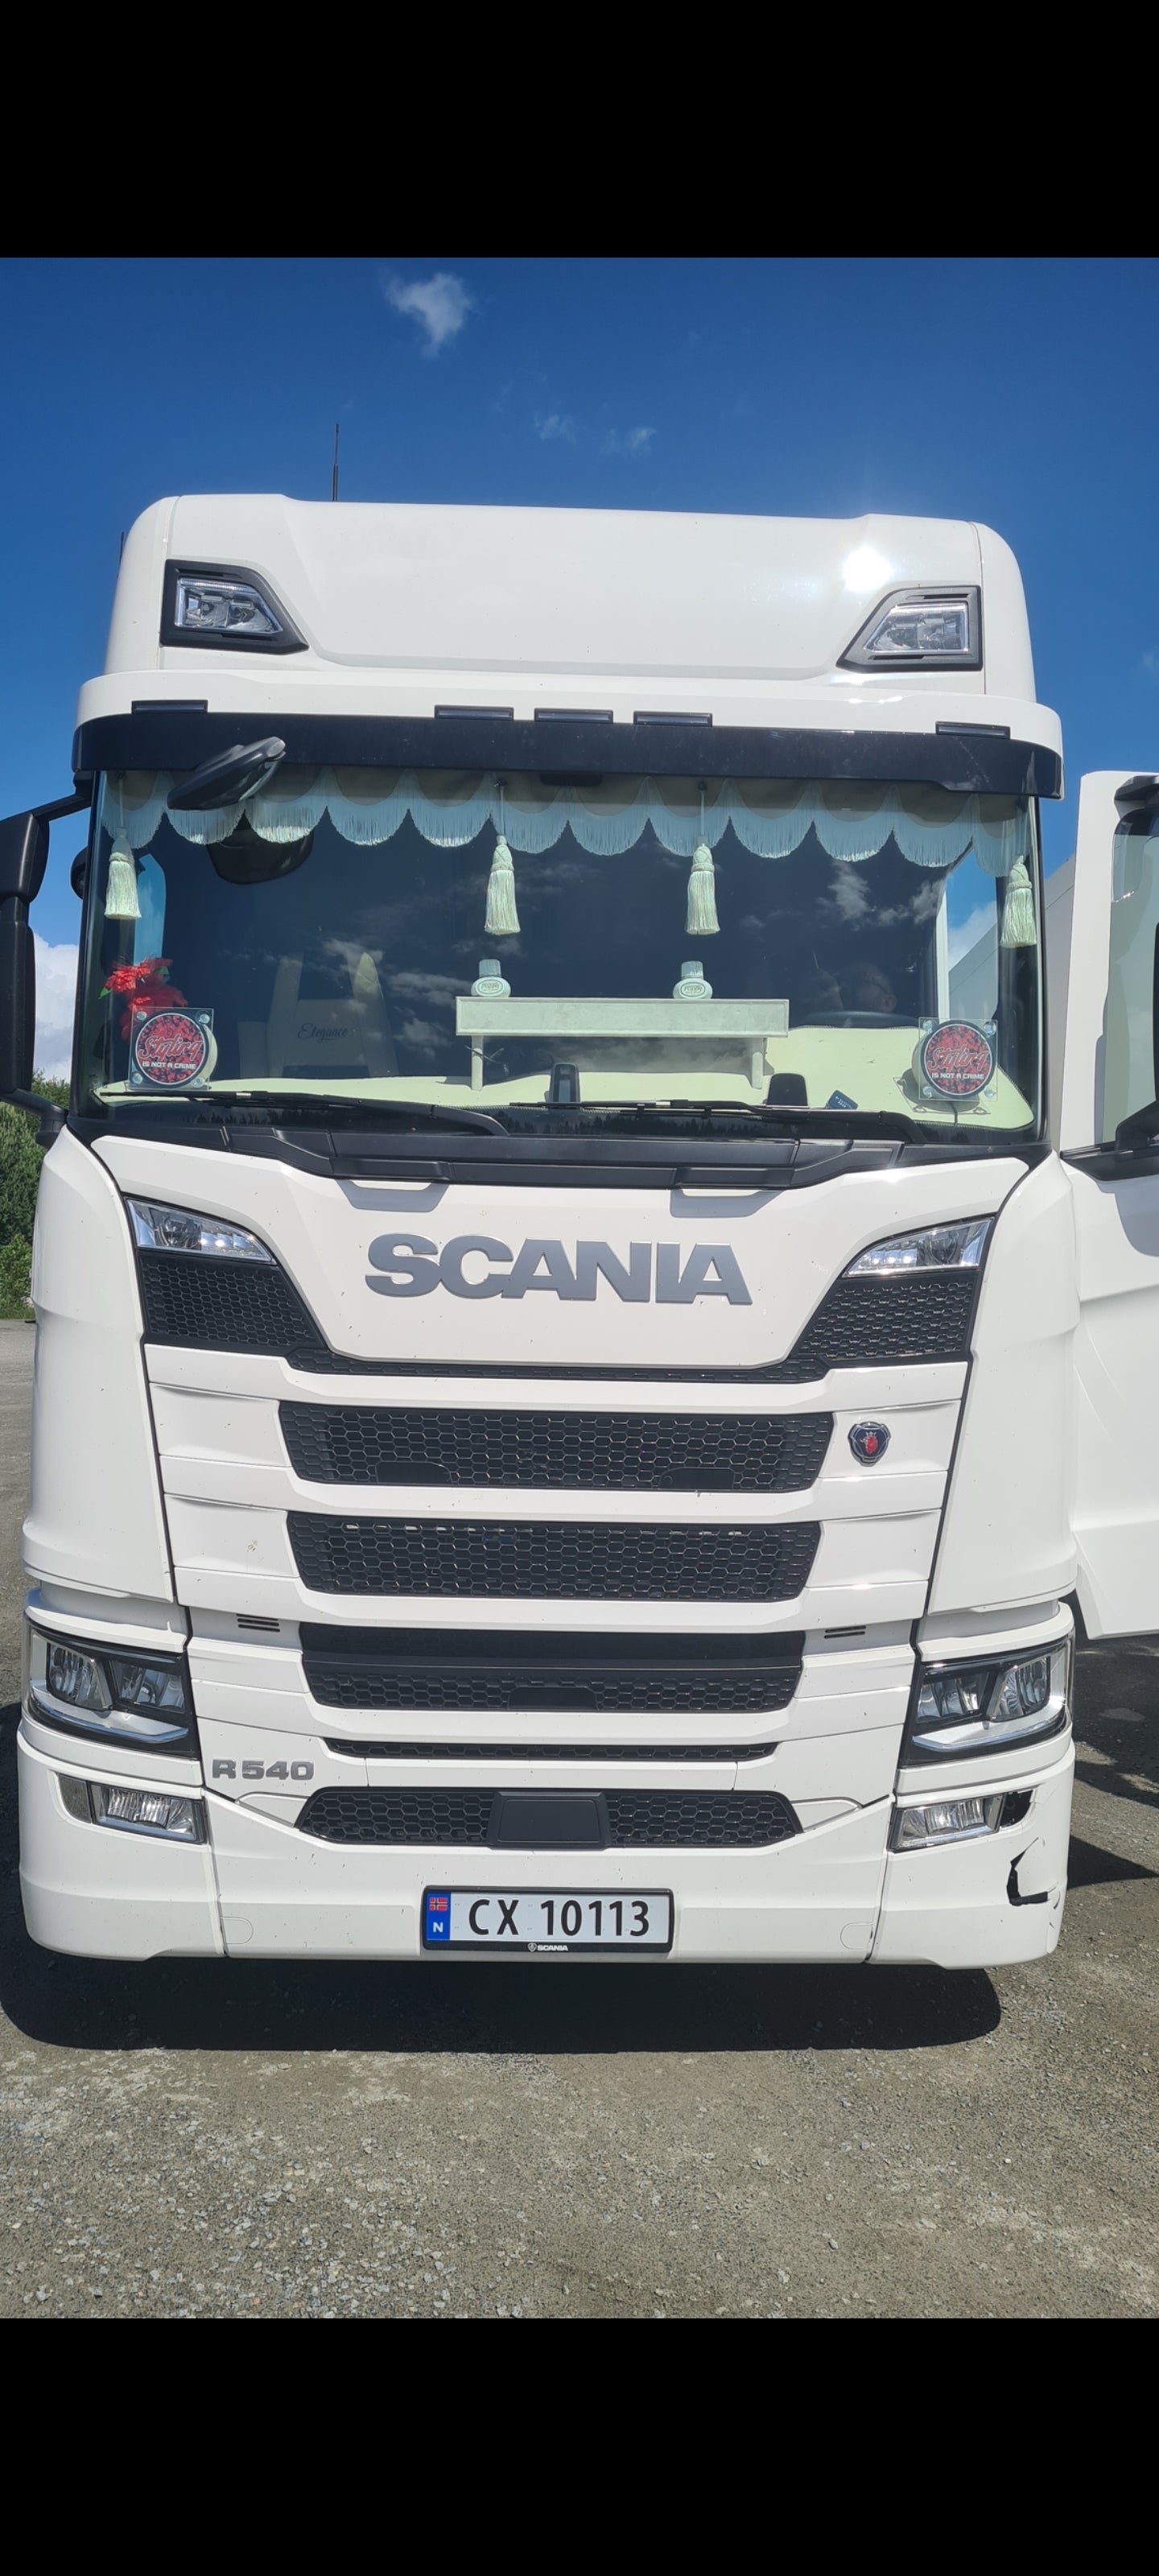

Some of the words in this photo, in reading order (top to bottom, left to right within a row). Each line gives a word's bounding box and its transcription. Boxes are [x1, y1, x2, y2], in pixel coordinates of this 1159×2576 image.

[297, 1022, 348, 1043] Elegance
[138, 1034, 204, 1061] Styling
[927, 1044, 990, 1072] Styling
[365, 1232, 753, 1306] SCANIA
[212, 1759, 237, 1779] R
[241, 1760, 315, 1781] 540
[432, 1922, 443, 1933] N
[468, 1899, 520, 1936] CX
[540, 1900, 650, 1937] 10113
